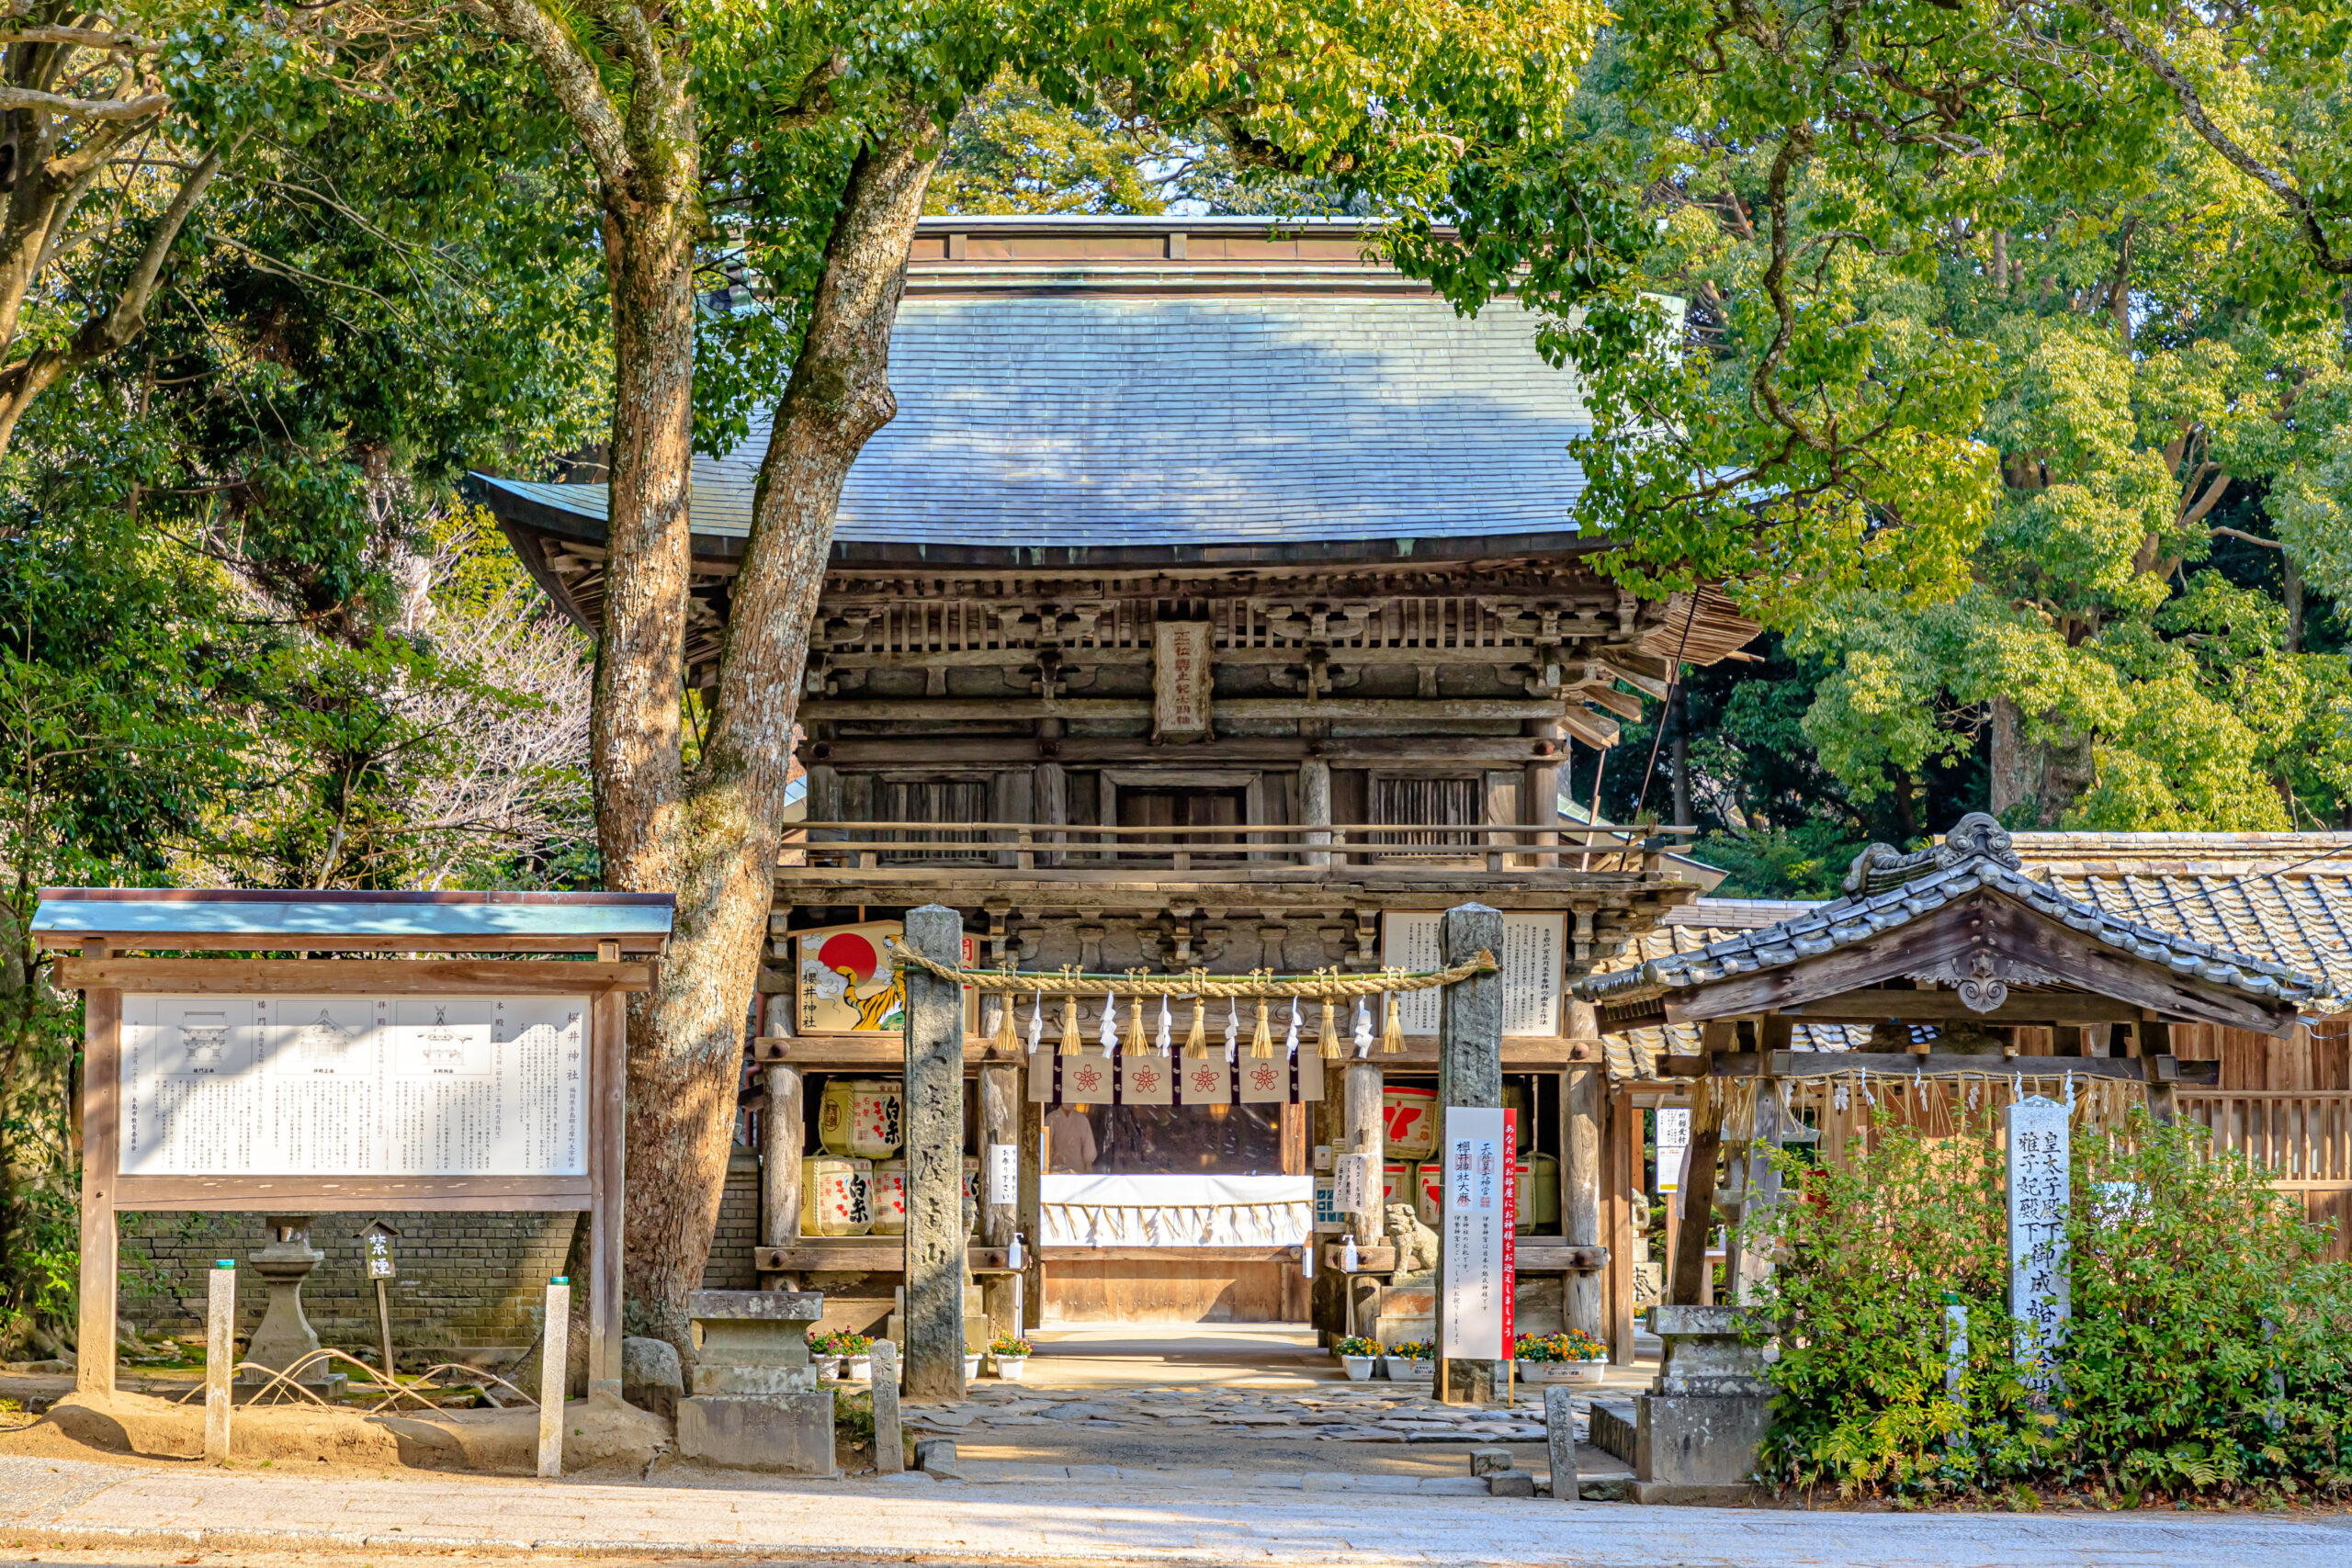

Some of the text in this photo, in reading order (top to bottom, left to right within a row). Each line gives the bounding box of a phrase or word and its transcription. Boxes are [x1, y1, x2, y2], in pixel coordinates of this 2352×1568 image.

[495, 1000, 504, 1027] 本殿
[802, 971, 817, 1029] 櫻井神社
[567, 1011, 580, 1080] 桜井神社
[884, 1095, 900, 1145] 白糸
[849, 1173, 868, 1224] 白糸
[1001, 1148, 1010, 1200] お参り下さい
[2018, 1131, 2041, 1243] 雅子妃殿下
[2041, 1131, 2064, 1242] 皇太子殿下
[368, 1232, 391, 1276] 禁煙
[1503, 1123, 1515, 1338] あなたのお部屋にお神様をお迎えしましょう
